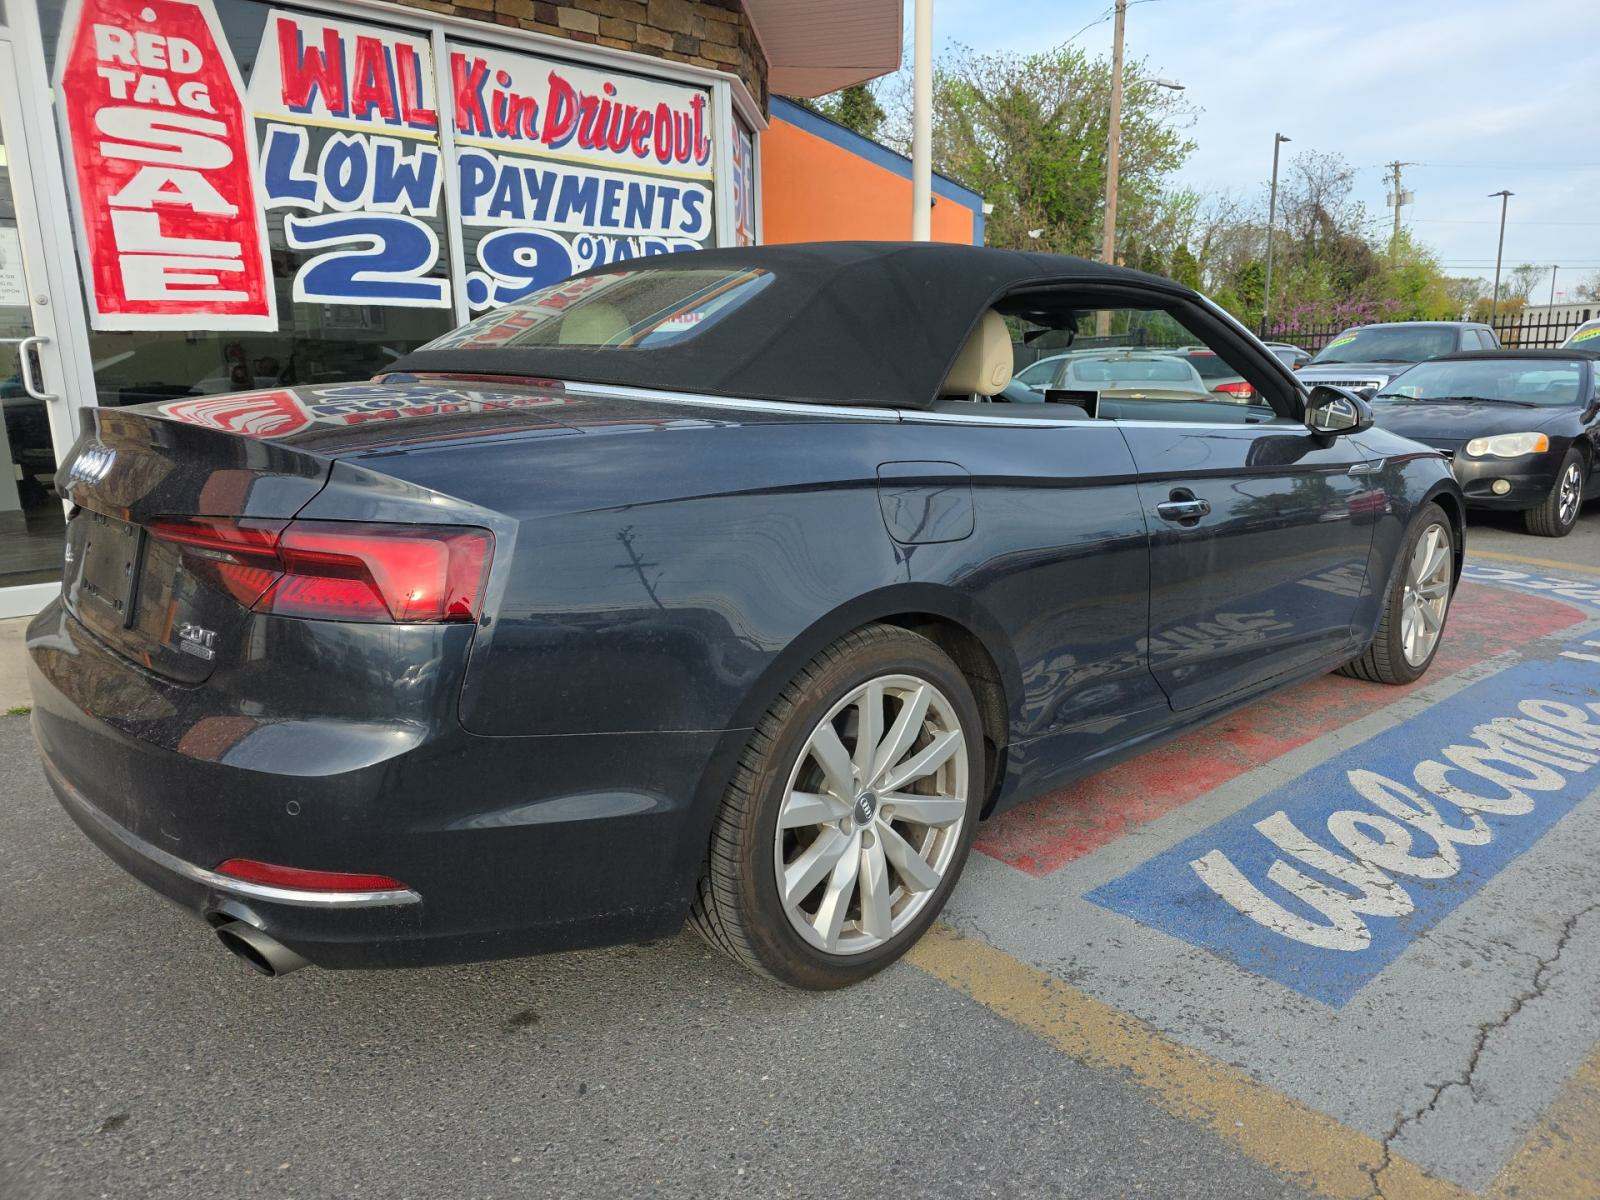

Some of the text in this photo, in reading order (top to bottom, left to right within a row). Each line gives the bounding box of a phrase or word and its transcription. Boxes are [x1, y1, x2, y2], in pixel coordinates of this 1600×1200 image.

[93, 24, 203, 74] RED
[97, 66, 218, 114] TAG
[540, 69, 653, 159] Drive
[94, 105, 250, 302] SALE
[263, 128, 440, 211] LOW
[457, 153, 707, 235] PAYMENTS
[1189, 699, 1600, 951] Welcome
